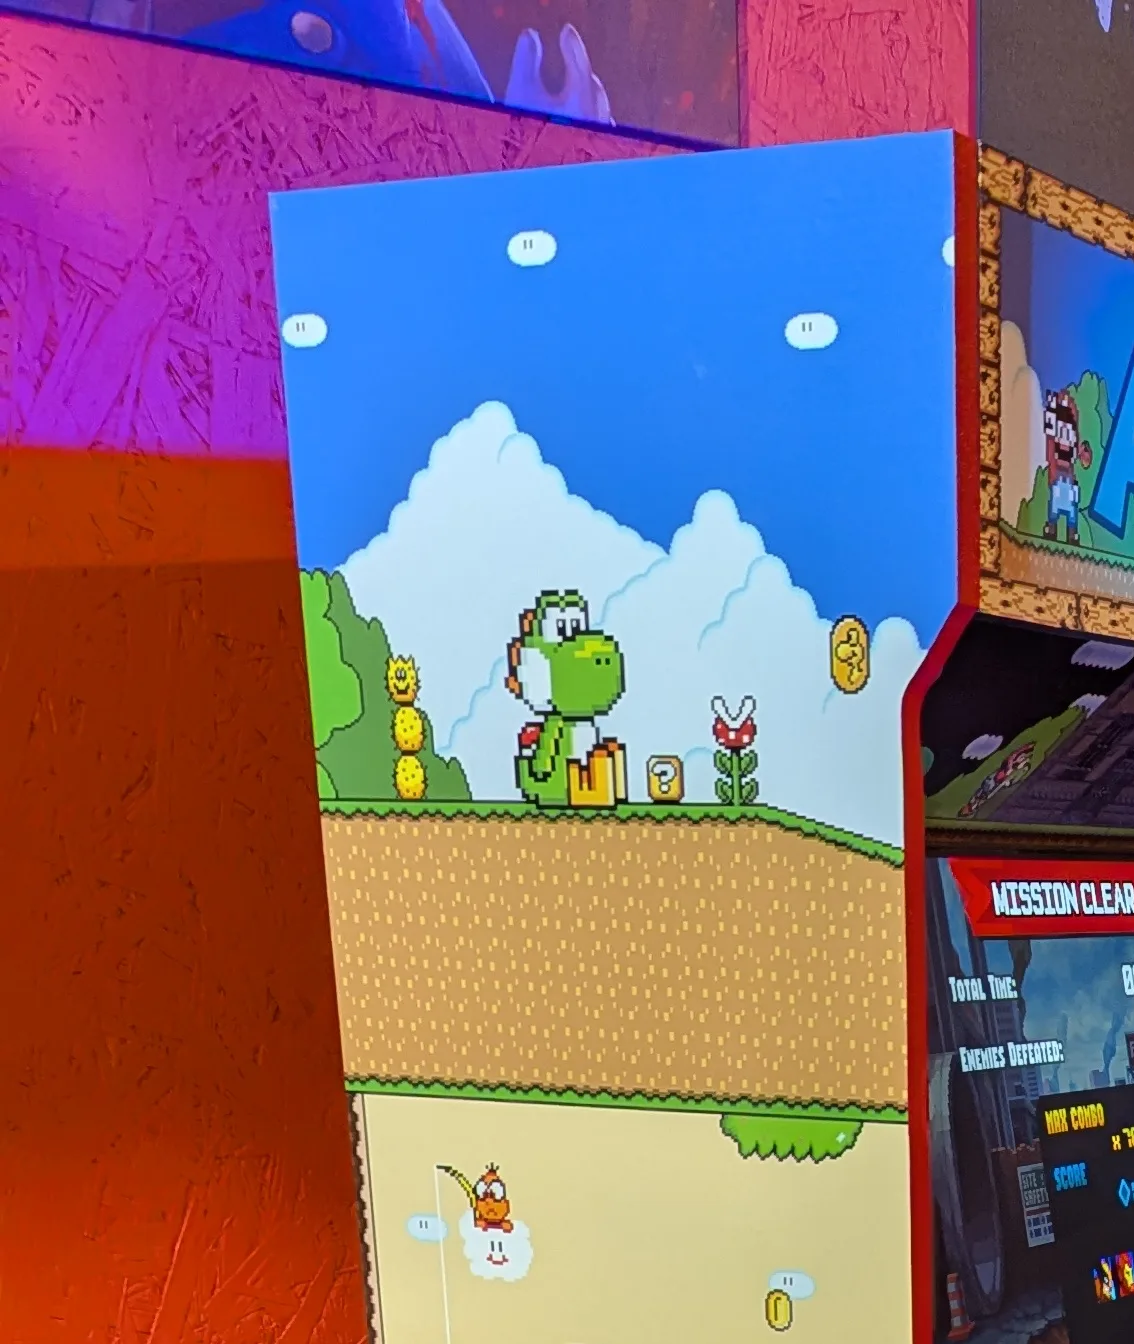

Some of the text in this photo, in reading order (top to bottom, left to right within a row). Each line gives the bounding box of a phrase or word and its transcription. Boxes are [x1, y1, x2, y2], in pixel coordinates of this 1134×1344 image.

[991, 881, 1079, 916] MISSION
[948, 974, 1018, 1002] TOTAL TIME:
[959, 1041, 1065, 1073] ENEMIES DEFEATED:
[1045, 1103, 1105, 1134] MAX COMBO
[1053, 1163, 1088, 1192] SCORE
